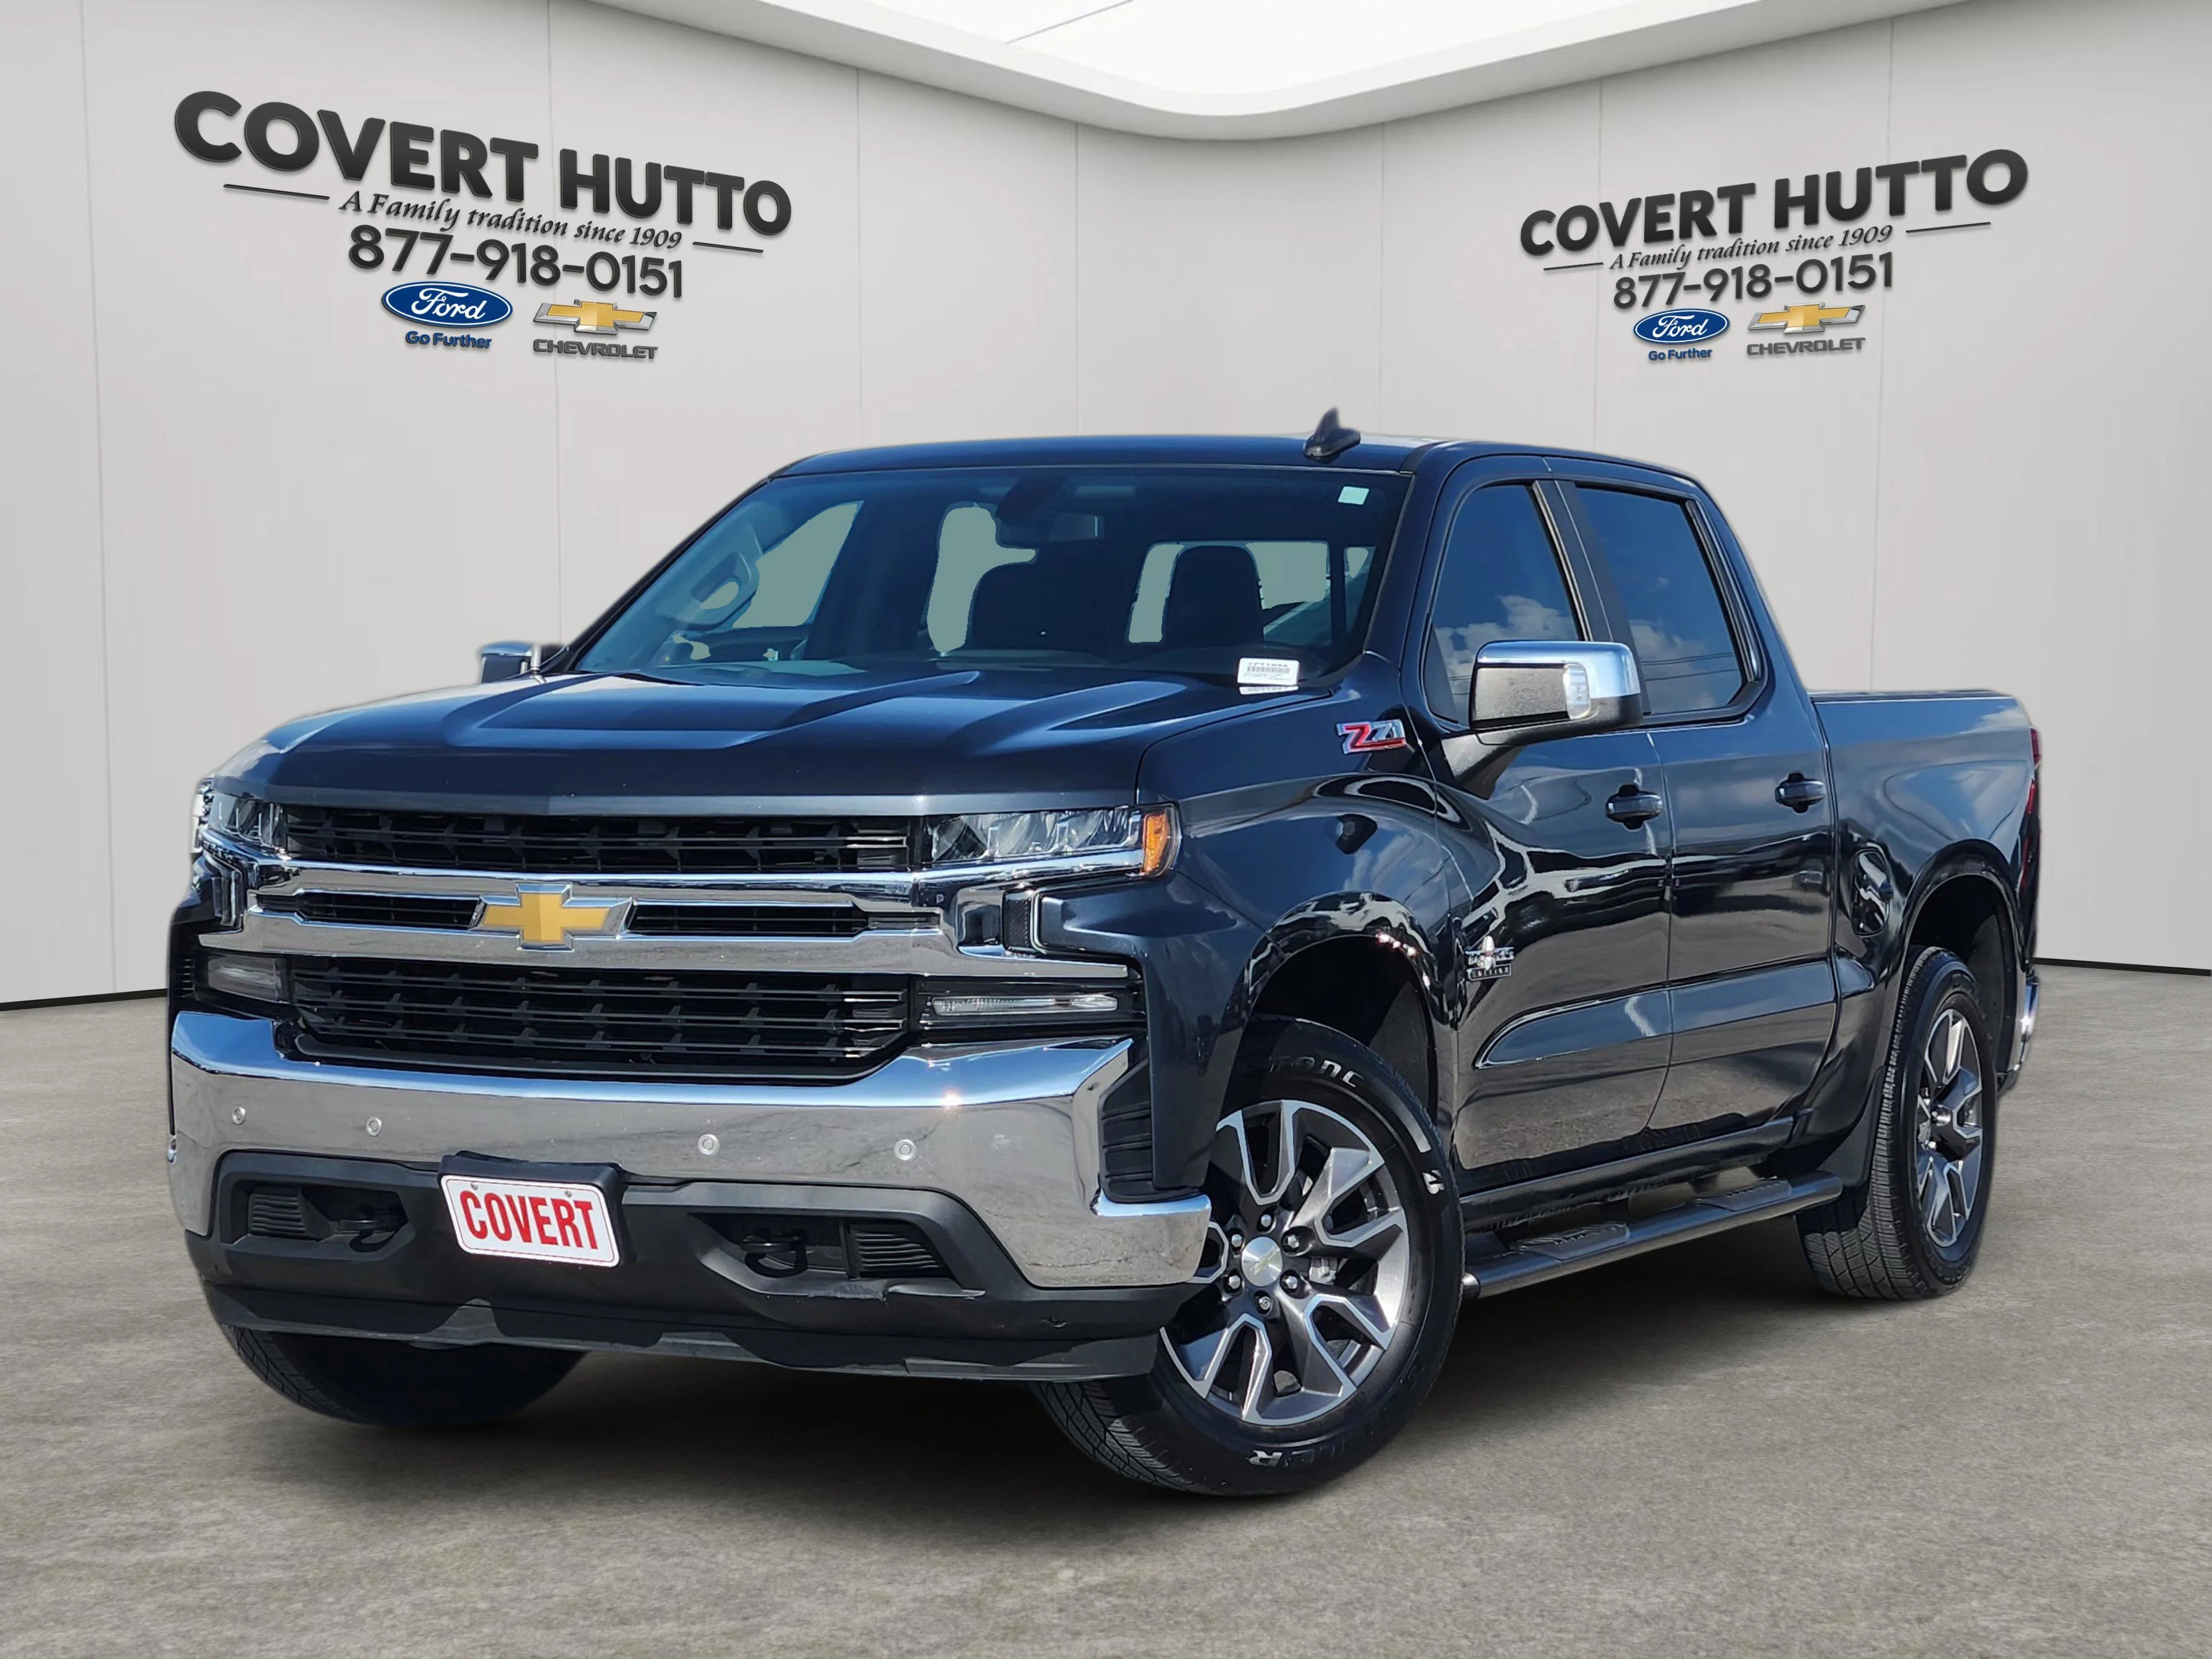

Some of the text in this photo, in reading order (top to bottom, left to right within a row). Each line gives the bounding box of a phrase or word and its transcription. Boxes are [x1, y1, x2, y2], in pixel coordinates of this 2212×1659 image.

[175, 91, 791, 236] COVERT HUTTO
[339, 191, 682, 249] A Family tradition since 1909
[1521, 149, 2028, 256] COVERT HUTTO
[349, 225, 681, 299] 877-918-0151
[1609, 225, 1893, 270] A Family tradition since 1909
[1614, 252, 1892, 310] 877-918-0151
[411, 288, 488, 320] Ford
[405, 331, 492, 348] Go Further
[1652, 315, 1709, 338] Ford
[1747, 337, 1866, 356] CHEVROLET
[534, 339, 658, 359] CHEVROLET
[1648, 347, 1713, 361] Go Further
[1336, 719, 1406, 754] Z71
[460, 1190, 598, 1250] COVERT
